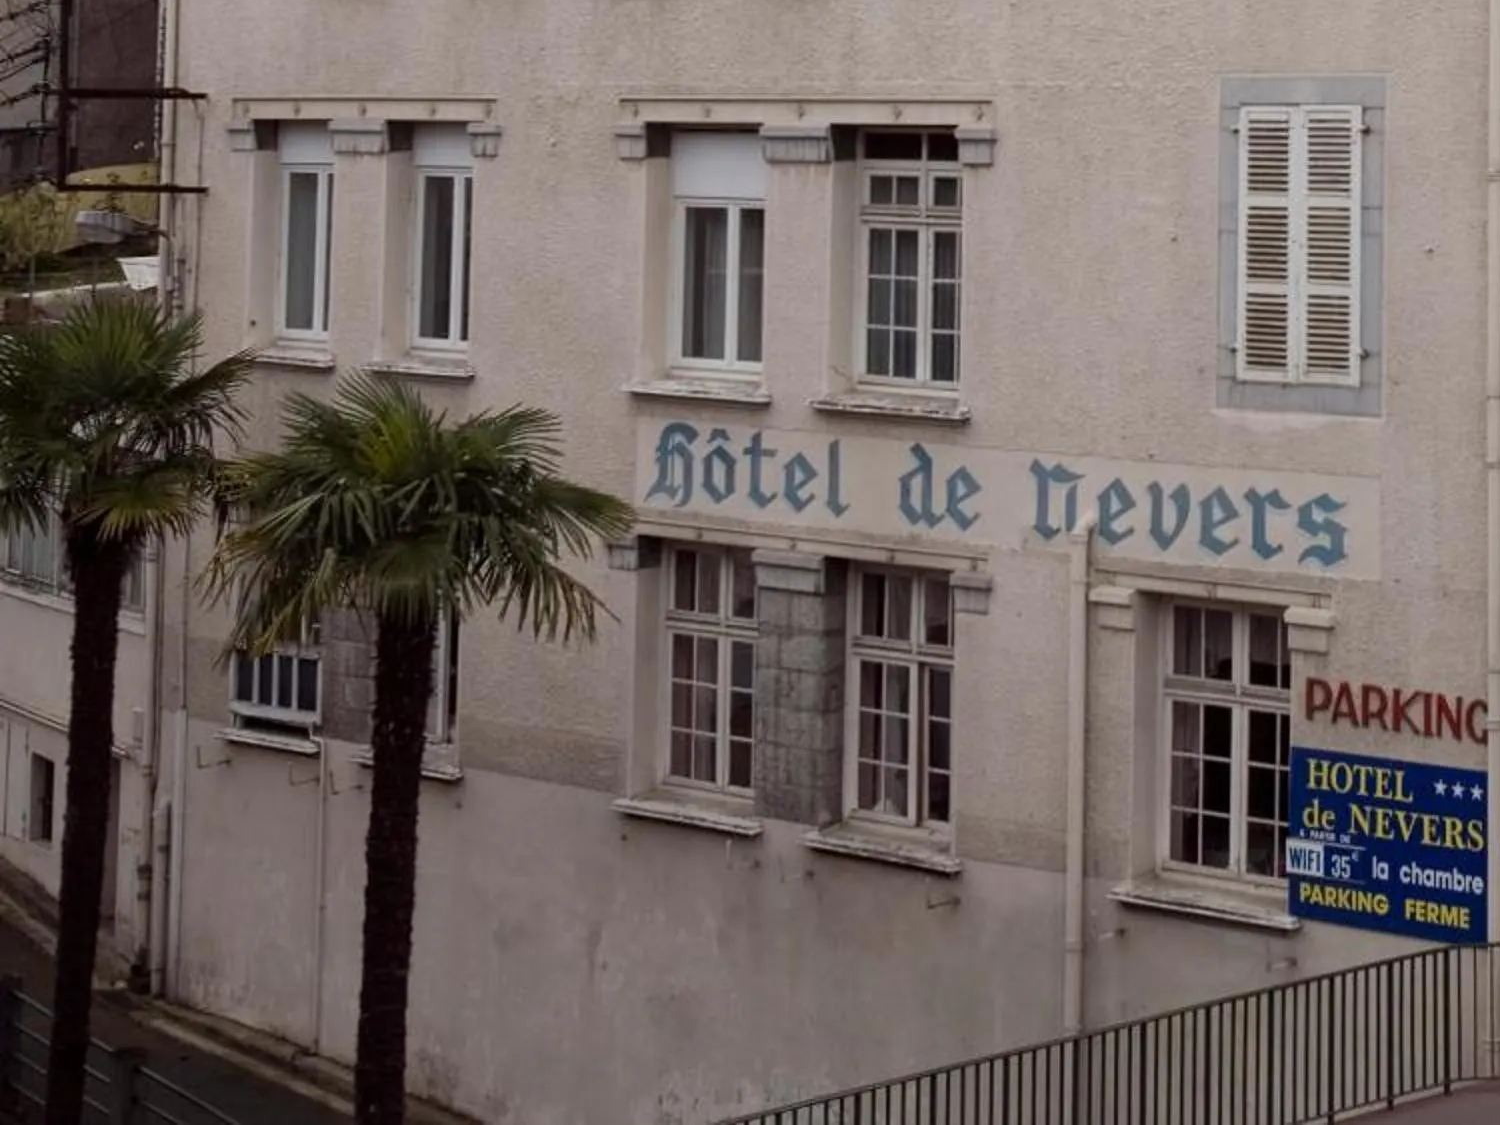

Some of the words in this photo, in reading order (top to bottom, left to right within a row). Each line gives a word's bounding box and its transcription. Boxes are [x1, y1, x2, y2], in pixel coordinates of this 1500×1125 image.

[644, 421, 850, 518] Hôtel
[899, 441, 982, 532] de
[1028, 457, 1349, 568] Nevers
[1305, 676, 1489, 746] PARKING
[1307, 758, 1413, 803] HOTEL
[1303, 796, 1336, 830] de
[1348, 803, 1484, 852] NEVERS
[1289, 846, 1322, 876] WIFI
[1372, 855, 1389, 881] la
[1400, 861, 1485, 895] chambre
[1300, 881, 1389, 916] PARKING
[1405, 897, 1471, 930] FERME
